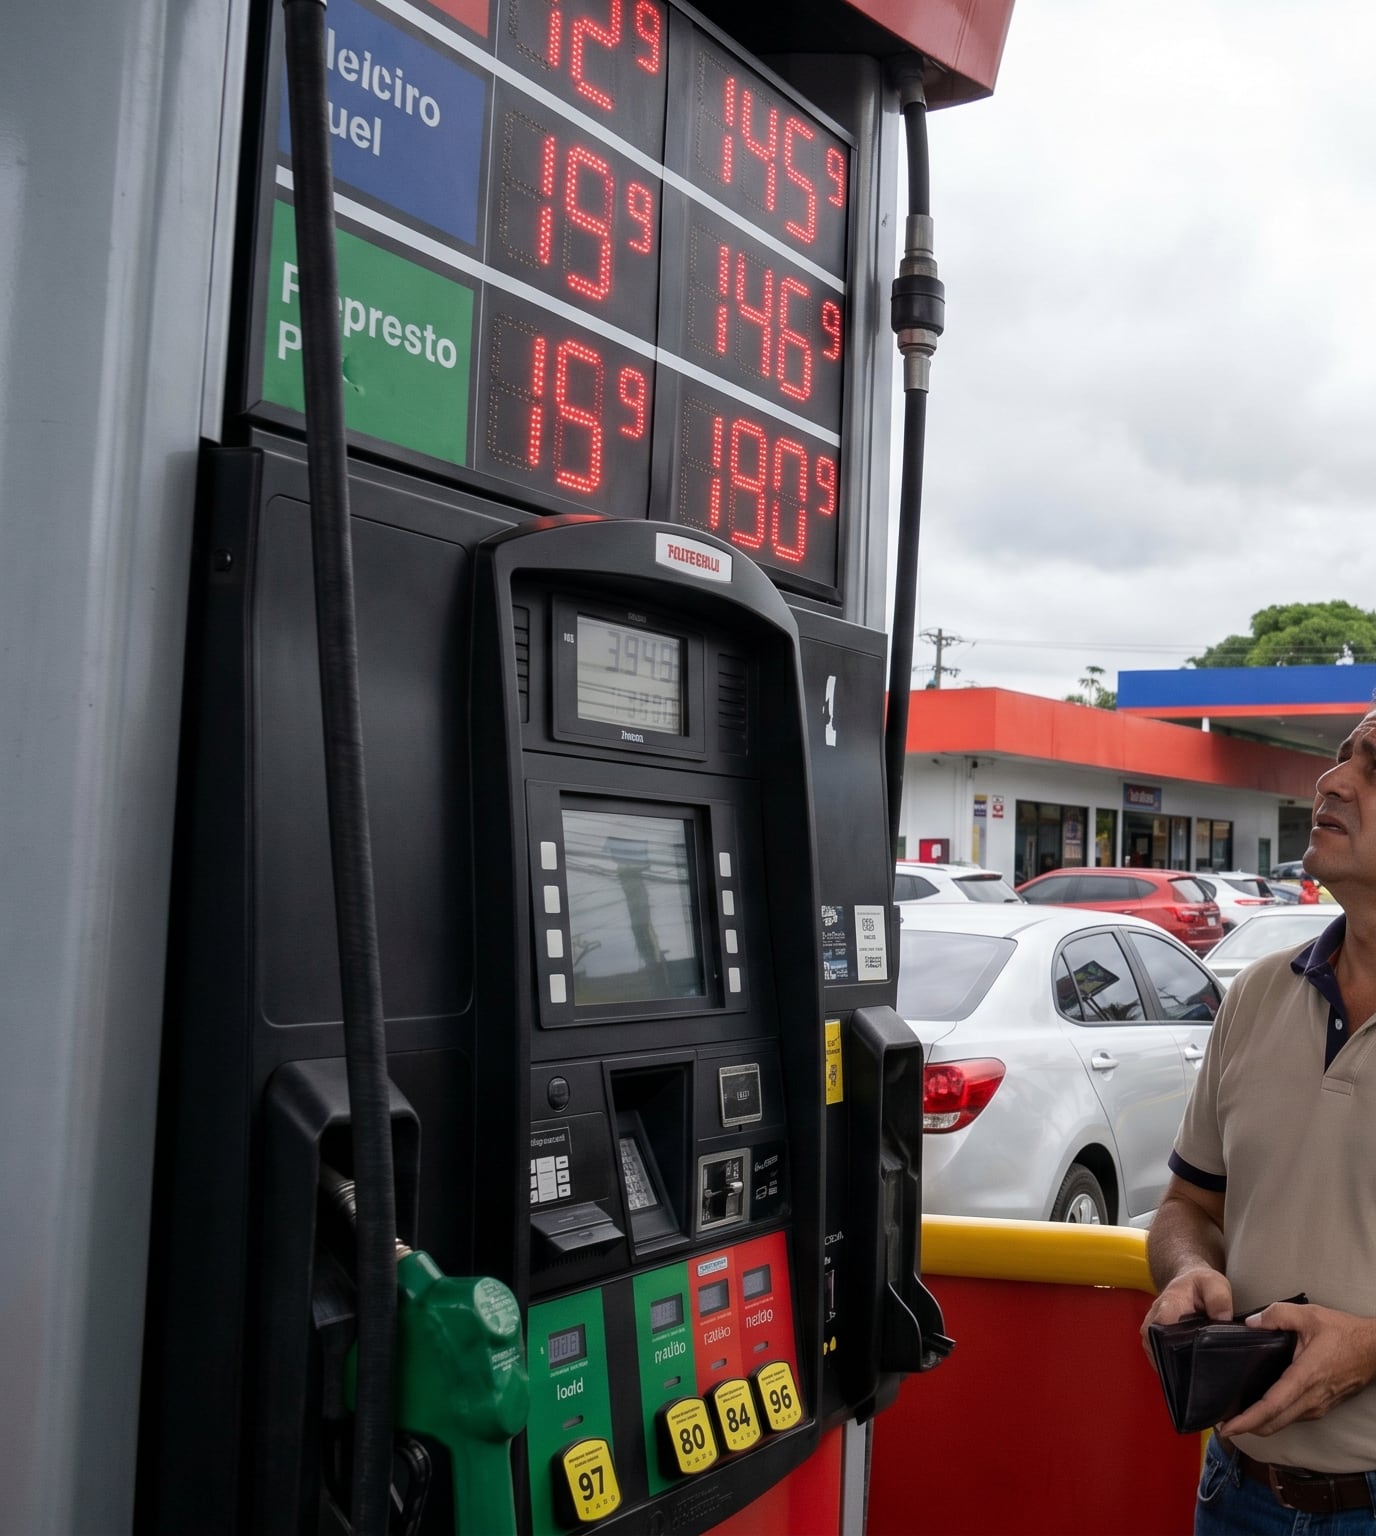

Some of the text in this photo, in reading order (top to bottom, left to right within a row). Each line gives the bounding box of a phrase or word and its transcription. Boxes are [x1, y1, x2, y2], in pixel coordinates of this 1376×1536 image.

[328, 100, 382, 157] uel
[769, 1383, 793, 1415] 96
[725, 1401, 752, 1434] 84
[679, 1422, 707, 1456] 80
[578, 1465, 604, 1502] 97
